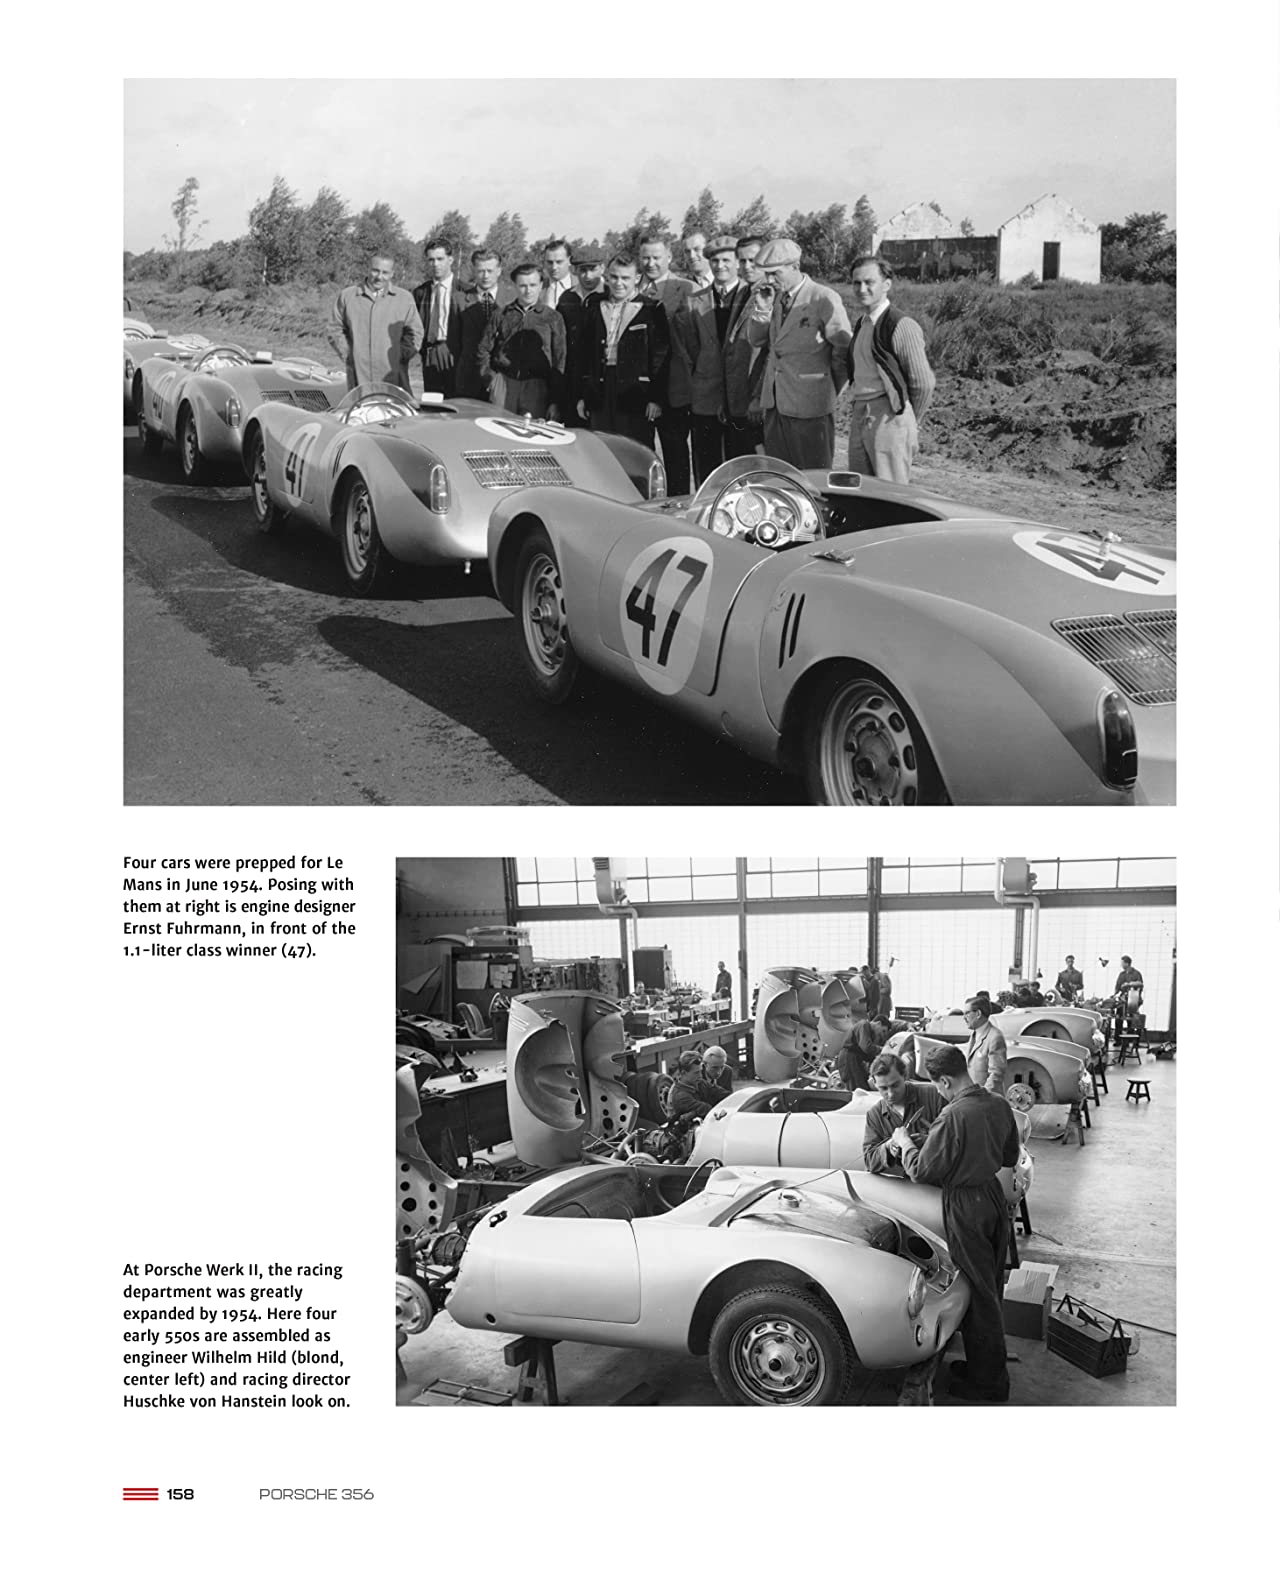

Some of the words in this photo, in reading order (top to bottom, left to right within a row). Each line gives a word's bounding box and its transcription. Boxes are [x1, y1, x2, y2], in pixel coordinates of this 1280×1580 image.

[286, 432, 316, 498] 41
[625, 548, 709, 668] 47
[123, 855, 157, 870] Four
[160, 858, 191, 870] cars
[194, 858, 231, 870] were
[235, 854, 296, 873] prepped
[300, 854, 323, 870] for
[327, 855, 344, 870] Le
[122, 877, 163, 892] Mans
[166, 877, 181, 891] in
[184, 877, 218, 894] June
[222, 879, 263, 894] 1954.
[268, 877, 318, 895] Posing
[320, 876, 354, 892] with
[122, 898, 162, 914] them
[165, 900, 181, 914] at
[185, 898, 221, 917] right
[224, 899, 238, 914] is
[240, 899, 290, 917] engine
[293, 898, 357, 917] designer
[123, 921, 163, 936] Ernst
[166, 920, 246, 939] Fuhrmann,
[250, 920, 265, 935] in
[269, 920, 308, 936] front
[311, 920, 328, 936] of
[331, 920, 357, 936] the
[122, 942, 183, 957] 1.1-liter
[186, 942, 223, 958] class
[225, 942, 278, 958] winner
[281, 942, 317, 959] (47).
[122, 1263, 140, 1277] At
[144, 1262, 203, 1277] Porsche
[205, 1262, 245, 1277] Werk
[248, 1263, 264, 1280] II,
[267, 1262, 293, 1277] the
[296, 1262, 344, 1281] racing
[122, 1283, 213, 1303] department
[216, 1287, 246, 1299] was
[249, 1284, 304, 1303] greatly
[122, 1305, 195, 1325] expanded
[199, 1305, 218, 1324] by
[221, 1308, 262, 1323] 1954.
[267, 1306, 302, 1321] Here
[305, 1305, 338, 1321] four
[122, 1327, 161, 1346] early
[164, 1331, 201, 1345] 550s
[204, 1331, 228, 1343] are
[232, 1327, 310, 1343] assembled
[314, 1331, 331, 1343] as
[122, 1350, 189, 1368] engineer
[191, 1349, 252, 1365] Wilhelm
[256, 1349, 287, 1365] Hild
[291, 1349, 344, 1368] (blond,
[122, 1373, 170, 1387] center
[174, 1371, 206, 1388] left)
[209, 1371, 238, 1387] and
[242, 1372, 289, 1390] racing
[291, 1371, 352, 1387] director
[123, 1393, 186, 1409] Huschke
[189, 1396, 217, 1409] von
[221, 1394, 287, 1409] Hanstein
[291, 1393, 324, 1409] look
[327, 1397, 351, 1409] on.
[166, 1488, 195, 1501] 158
[259, 1488, 338, 1501] PORSCHE
[341, 1488, 375, 1501] 356
